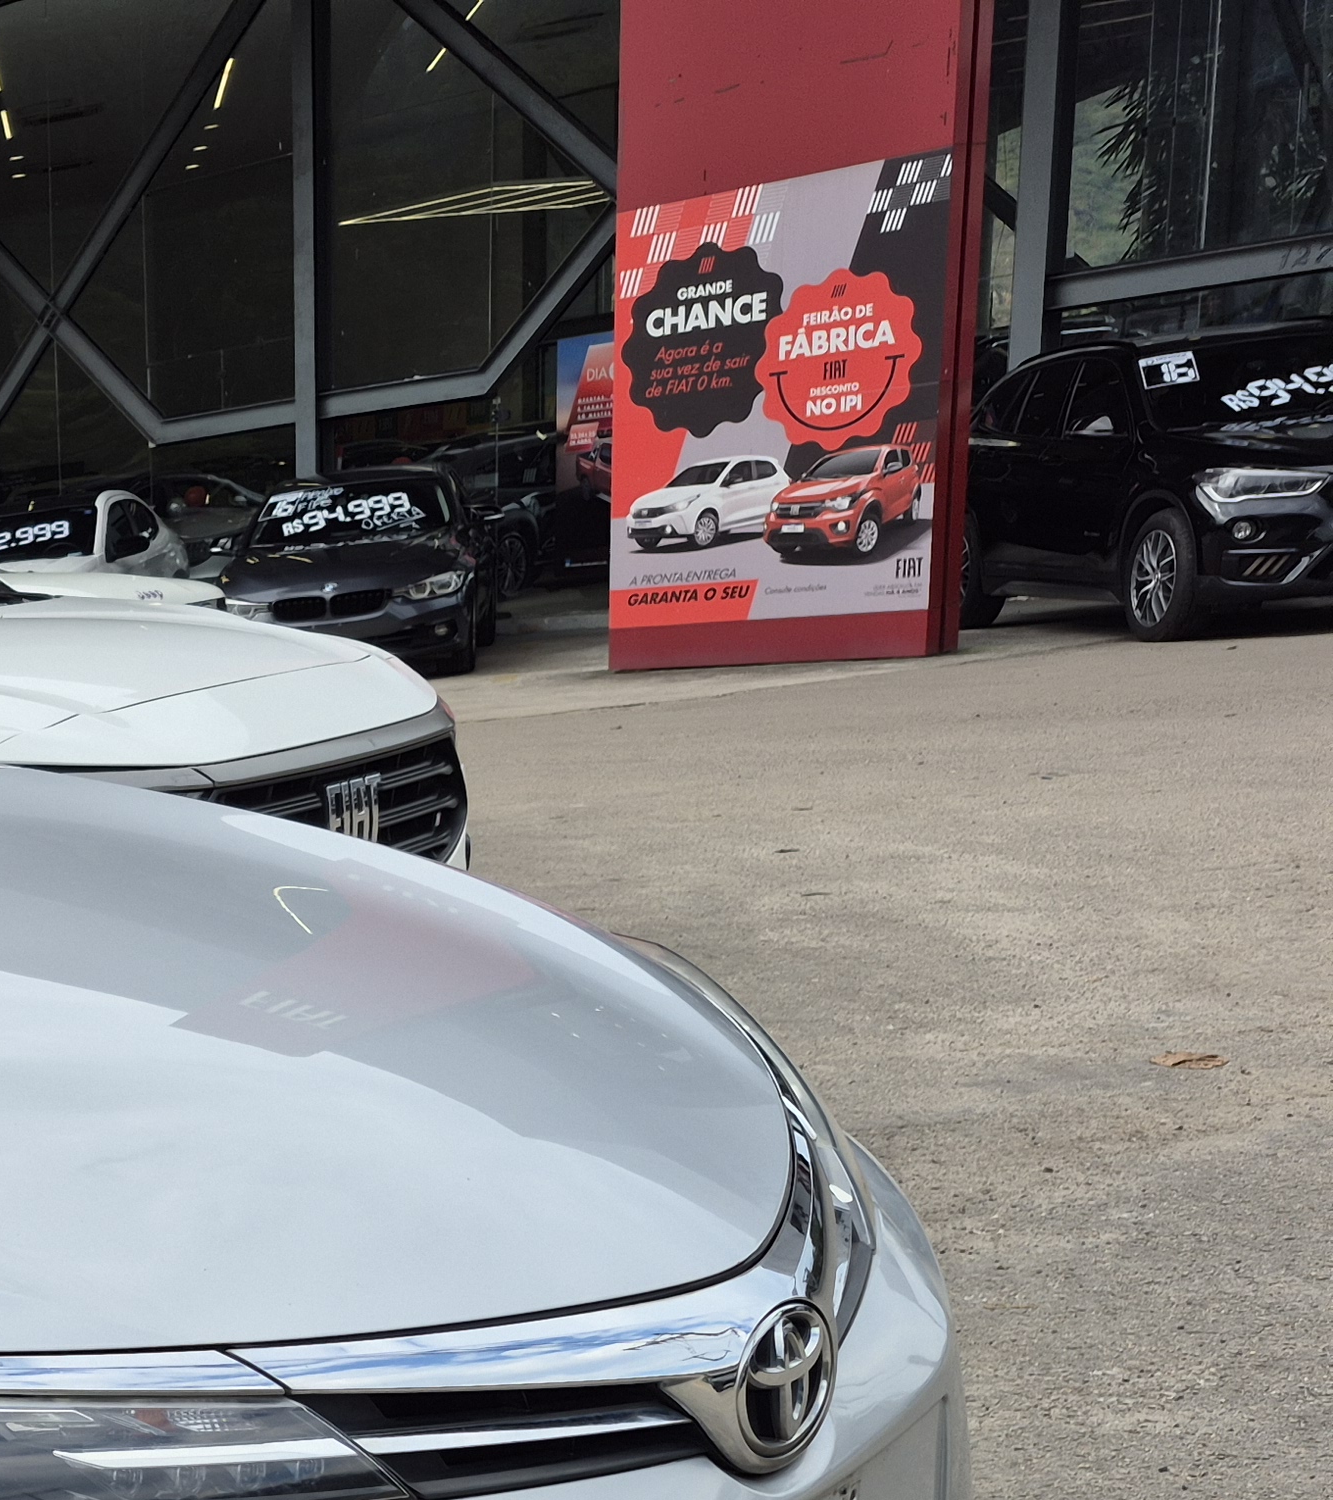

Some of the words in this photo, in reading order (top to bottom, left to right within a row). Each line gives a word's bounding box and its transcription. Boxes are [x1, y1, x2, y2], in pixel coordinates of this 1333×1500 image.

[677, 279, 733, 300] GRANDE
[646, 291, 767, 338] CHANCE
[803, 305, 852, 327] FEIRÃO
[855, 303, 873, 318] DE
[778, 319, 895, 361] FÁBRICA
[654, 346, 697, 365] Agora
[700, 339, 710, 355] é
[713, 342, 723, 353] a
[587, 367, 607, 382] DIA
[650, 368, 673, 380] sua
[677, 362, 700, 375] vez
[703, 355, 721, 372] de
[724, 353, 750, 369] sair
[823, 359, 848, 380] FIAT
[645, 382, 662, 398] de
[665, 376, 695, 395] FIAT
[809, 382, 859, 398] DESCONTO
[806, 397, 837, 418] NO
[840, 393, 862, 413] IPI
[895, 557, 923, 578] FIAT
[629, 577, 637, 586] A
[628, 589, 698, 606] GARANTA
[704, 587, 717, 601] O
[721, 585, 750, 600] SEU
[326, 773, 381, 843] FIAT
